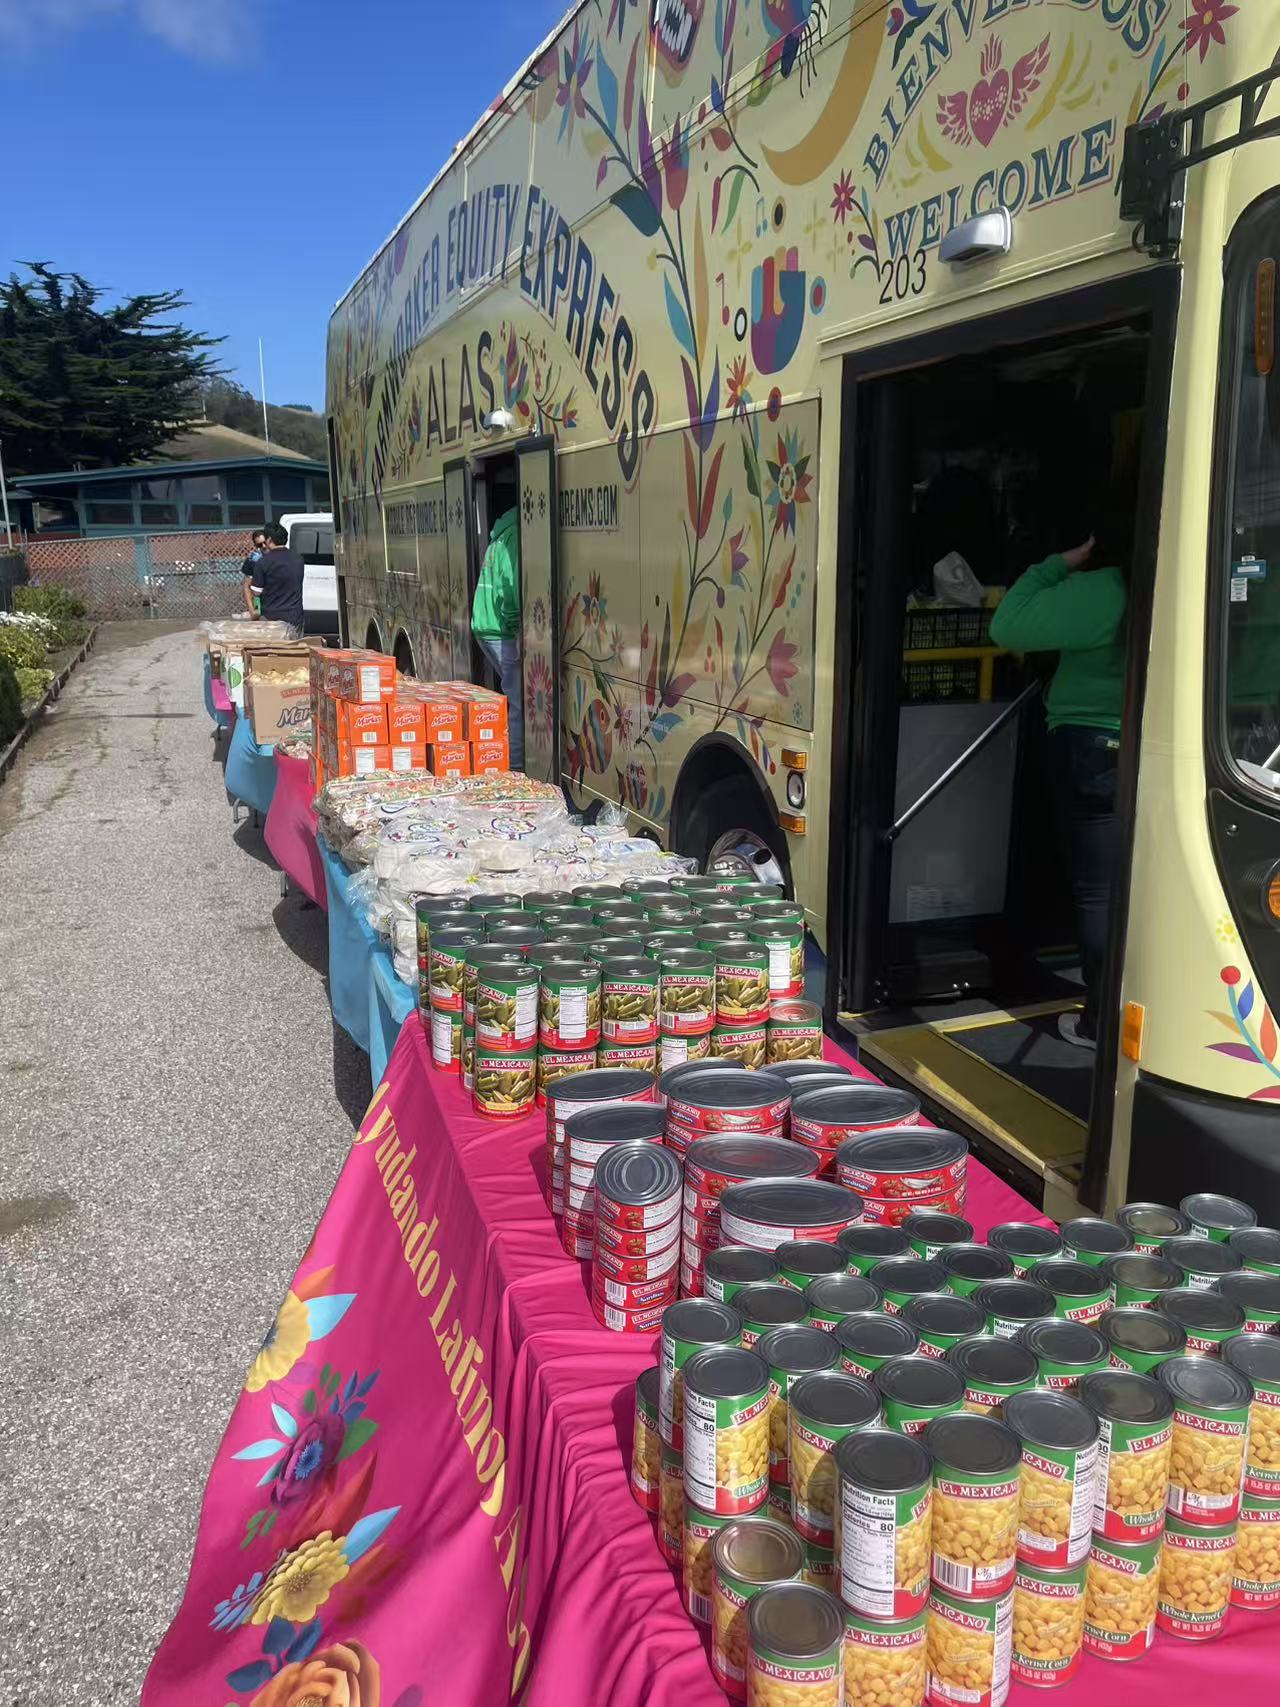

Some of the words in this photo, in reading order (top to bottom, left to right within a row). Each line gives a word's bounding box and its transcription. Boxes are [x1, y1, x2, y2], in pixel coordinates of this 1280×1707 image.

[884, 119, 1117, 260] WELCOME
[879, 249, 926, 304] 203
[447, 184, 524, 290] EQUITY
[520, 184, 655, 484] EXPRESS
[428, 330, 497, 449] ALAS
[277, 706, 312, 728] Mar
[556, 1054, 593, 1063] MEXICAN
[616, 1049, 653, 1058] MEXICAN
[355, 1081, 440, 1297] yudando
[1069, 1310, 1084, 1320] EL
[842, 1360, 874, 1383] CANO
[1050, 1378, 1066, 1387] EL
[698, 1396, 715, 1409] Facts
[969, 1391, 1004, 1406] MEXIC
[704, 1422, 715, 1432] 80
[1176, 1411, 1241, 1434] MEXICANO
[1133, 1440, 1148, 1451] EL
[1022, 1450, 1063, 1477] ICANO
[844, 1482, 870, 1503] Nutrition
[873, 1496, 895, 1506] Facts
[942, 1483, 957, 1494] EL
[961, 1480, 1017, 1498] MEXICAN
[1241, 1511, 1256, 1521] EL
[694, 1528, 706, 1537] EL
[880, 1523, 893, 1532] 80
[1168, 1535, 1182, 1546] EL
[1185, 1536, 1235, 1550] MEXICAN
[1091, 1549, 1136, 1573] XICANO
[1234, 1578, 1261, 1591] Whole
[717, 1580, 746, 1608] CANO
[931, 1599, 984, 1629] EXICANO
[1162, 1603, 1190, 1620] Whole
[1190, 1610, 1216, 1622] Kernel
[861, 1628, 924, 1646] MEXICANO
[1104, 1632, 1127, 1642] Corn
[1018, 1652, 1048, 1669] Kernel
[1047, 1658, 1068, 1670] Corn
[765, 1665, 834, 1681] MEXICANO
